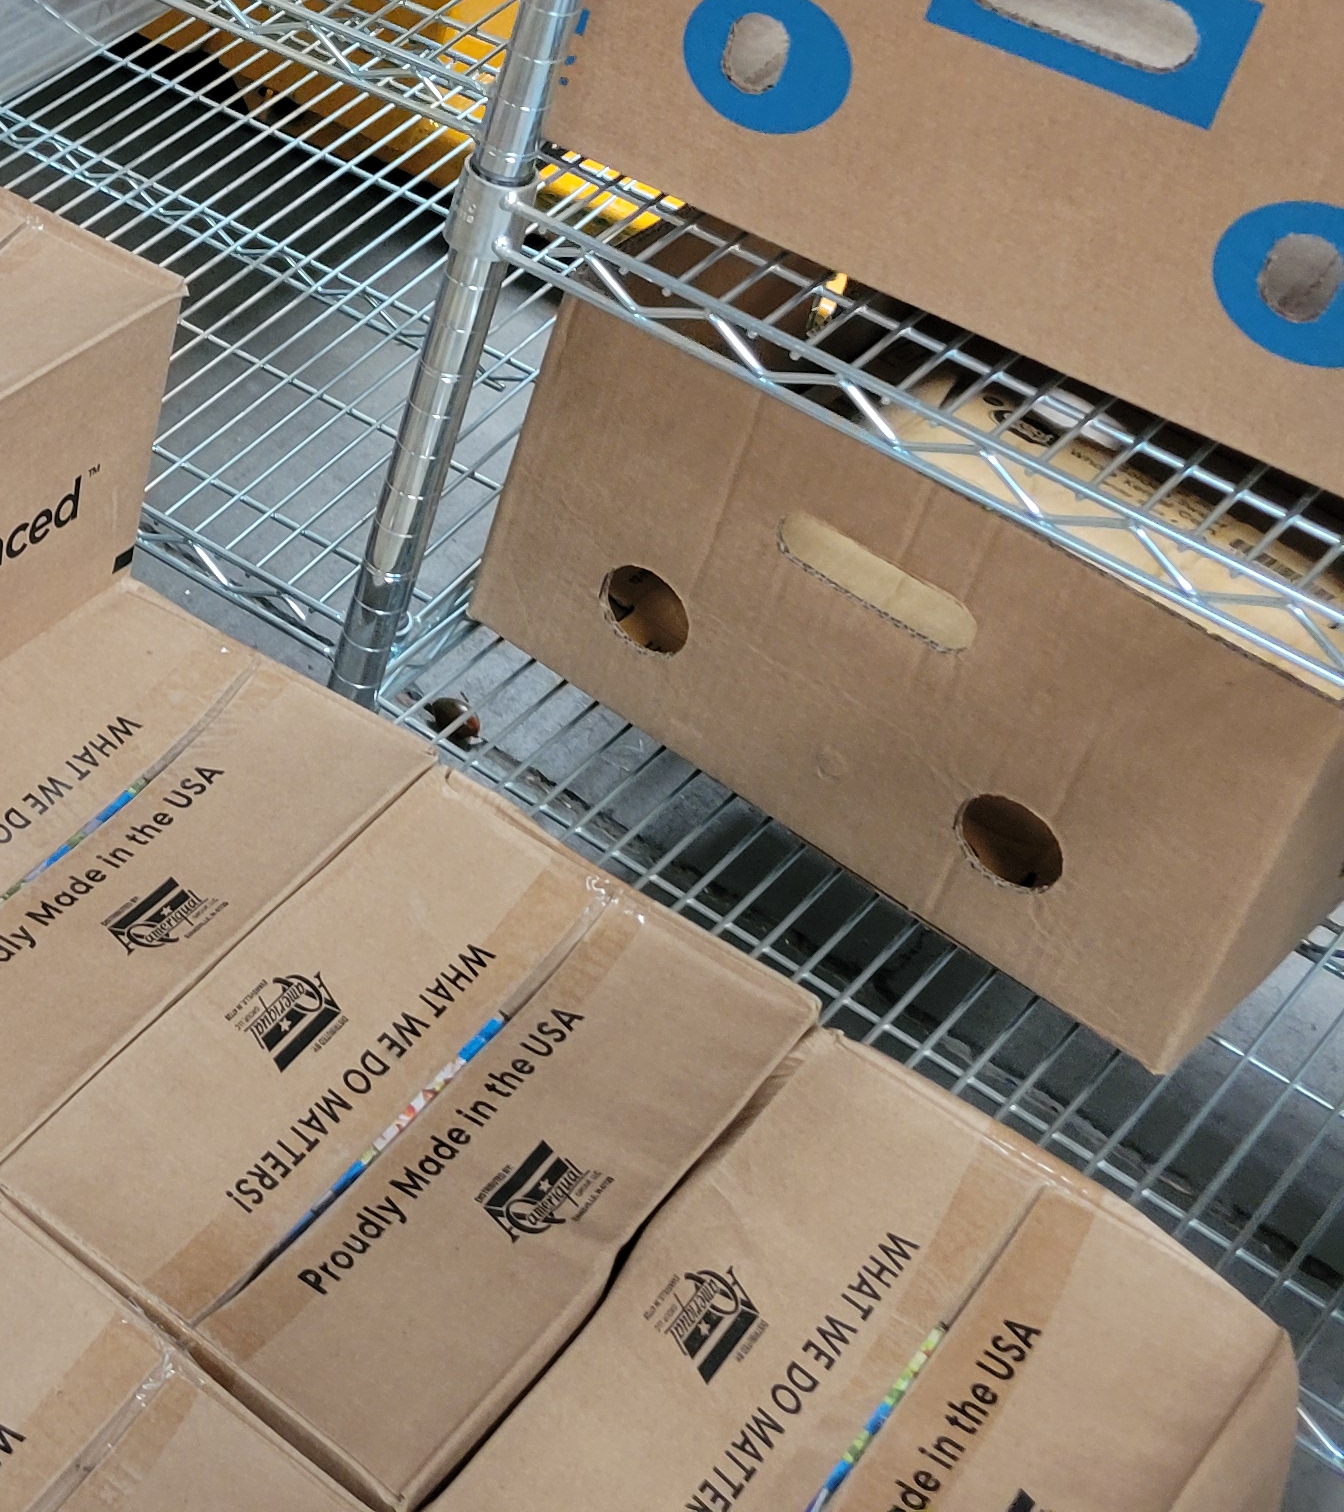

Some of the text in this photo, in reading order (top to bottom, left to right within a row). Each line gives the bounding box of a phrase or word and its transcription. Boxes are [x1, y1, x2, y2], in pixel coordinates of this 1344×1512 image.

[64, 715, 144, 782] WHAT
[22, 775, 74, 814] WE
[25, 868, 107, 929] Made
[106, 845, 135, 869] in
[126, 813, 174, 848] the
[163, 765, 225, 809] USA
[226, 944, 497, 1214] WHAT WE DO MATTERS!
[297, 1009, 586, 1296] Proudly Made in the USA
[841, 1232, 919, 1322] WHAT
[802, 1315, 858, 1371] WE
[771, 1362, 821, 1416] DO
[917, 1319, 1042, 1469] in the USA
